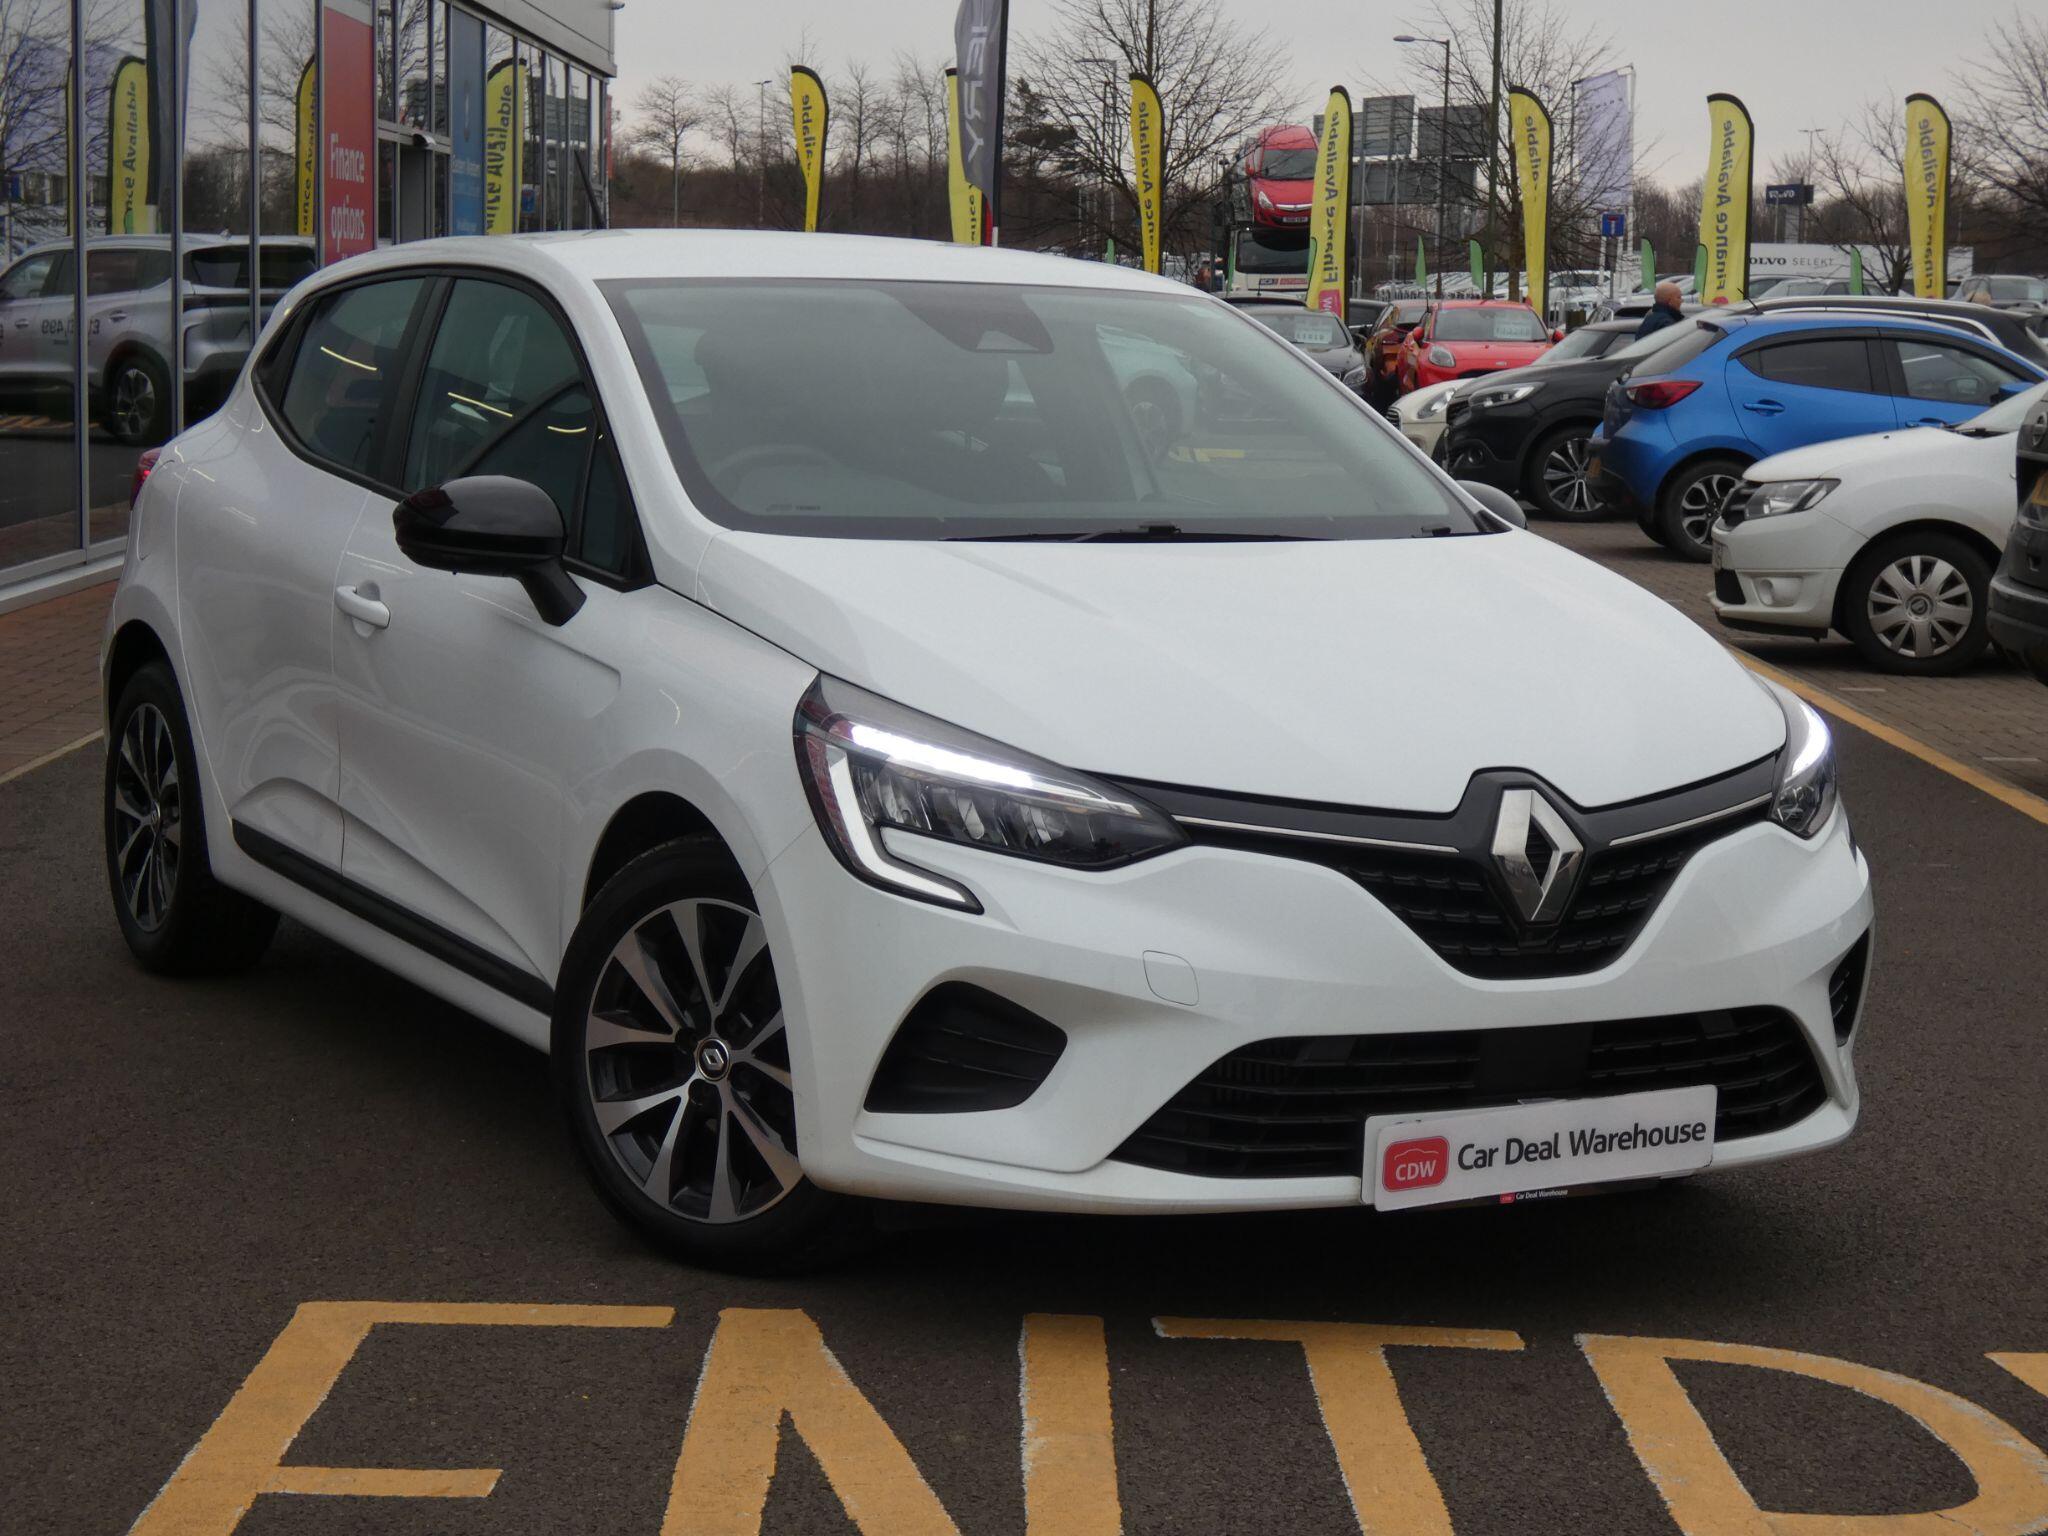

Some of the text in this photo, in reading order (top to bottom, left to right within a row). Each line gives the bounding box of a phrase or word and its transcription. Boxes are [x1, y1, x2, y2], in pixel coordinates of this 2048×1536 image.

[330, 132, 365, 184] Finance
[330, 194, 365, 252] options
[1749, 257, 1787, 266] OLVO
[1395, 1121, 1707, 1181] CDW Car Deal Warehouse
[1525, 1191, 1537, 1199] Deal
[1538, 1189, 1569, 1198] Warehouse
[128, 1299, 2048, 1536] ENTR
